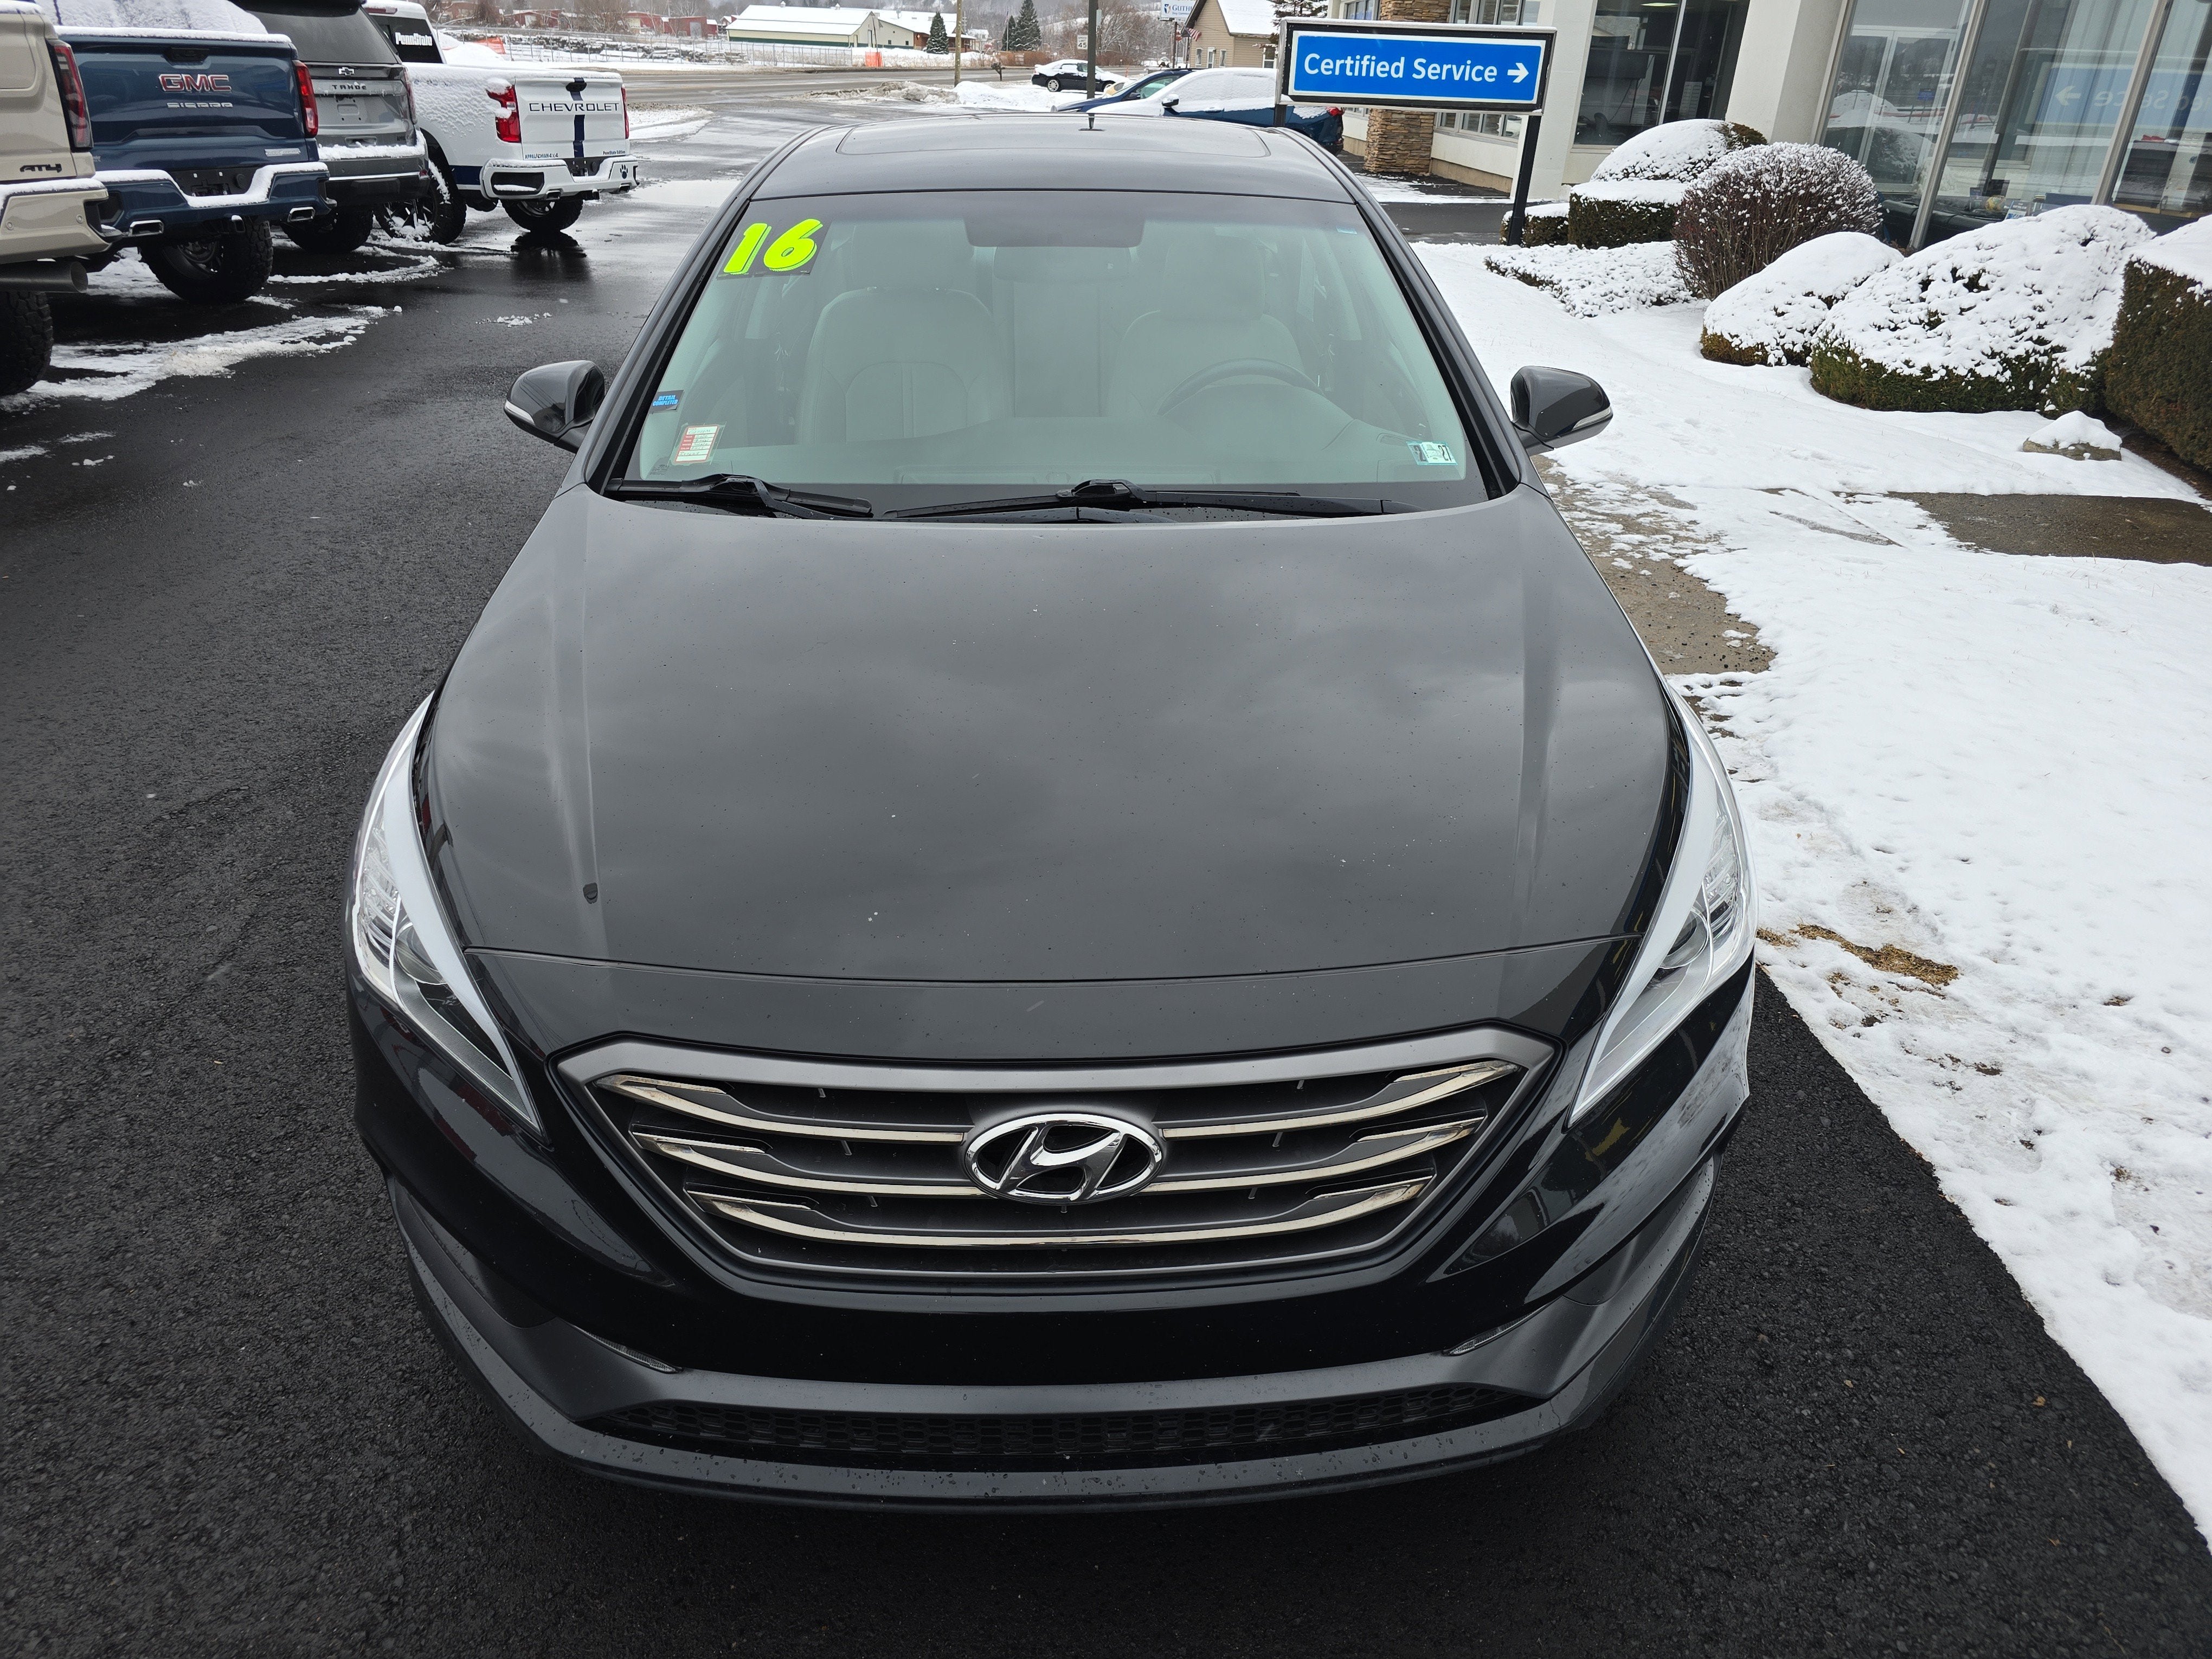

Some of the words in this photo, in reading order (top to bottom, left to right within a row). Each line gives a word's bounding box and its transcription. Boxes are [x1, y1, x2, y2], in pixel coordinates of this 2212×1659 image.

[1304, 53, 1405, 78] Certified
[1412, 58, 1497, 82] Service
[159, 74, 232, 92] GMC
[529, 103, 619, 112] CHEVROLET
[20, 164, 62, 173] AT4
[723, 218, 823, 275] 16
